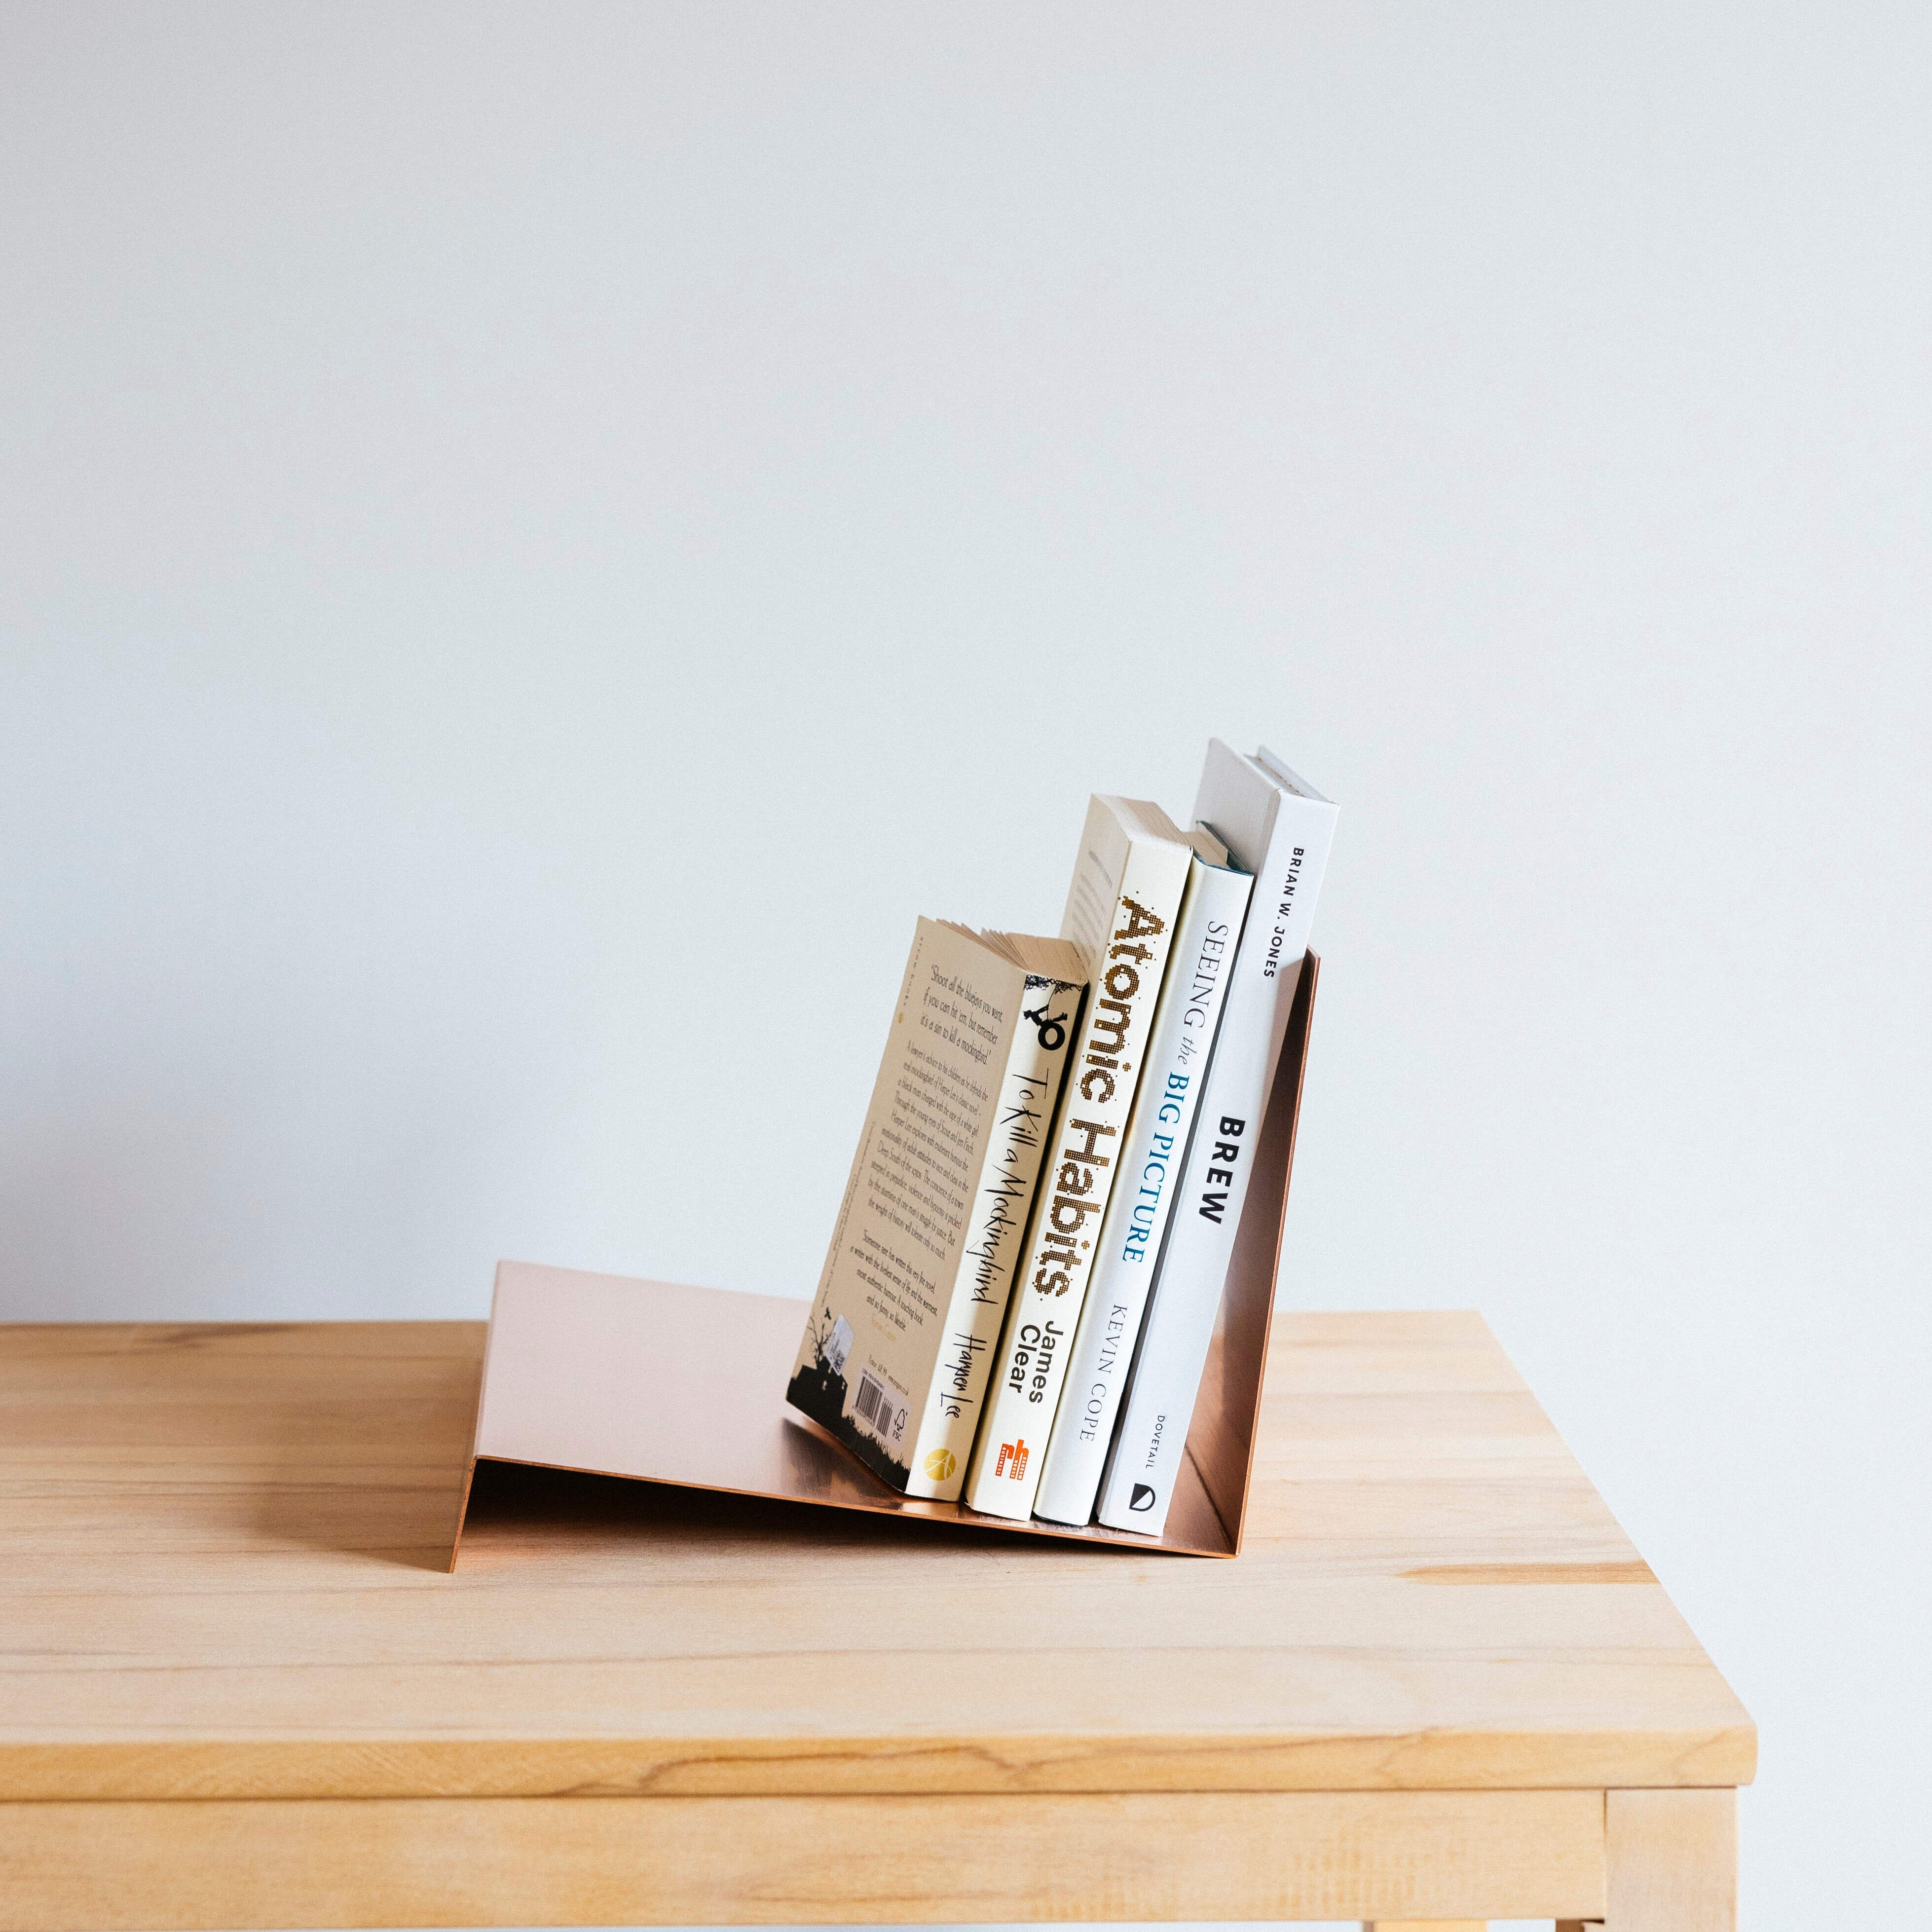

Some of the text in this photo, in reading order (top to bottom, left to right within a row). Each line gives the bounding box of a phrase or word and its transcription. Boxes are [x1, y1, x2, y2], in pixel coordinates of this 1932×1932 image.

[1264, 847, 1304, 978] BRIAN W. JONES
[924, 987, 930, 1005] if
[928, 996, 939, 1008] you
[940, 1002, 950, 1014] can
[976, 1024, 998, 1044] remember
[949, 976, 958, 991] all
[965, 984, 982, 1009] bluejays
[982, 1002, 991, 1014] you
[992, 1008, 1003, 1023] want,
[1078, 894, 1166, 1104] Atomic
[942, 1028, 948, 1039] to
[949, 1026, 958, 1043] kill
[957, 1038, 961, 1046] a
[933, 1076, 939, 1090] of
[938, 1078, 950, 1096] Harper
[968, 1104, 979, 1116] novel
[948, 1066, 961, 1083] children
[965, 1076, 970, 1089] he
[969, 1078, 982, 1098] defends
[1122, 921, 1228, 1263] SEEING the BIG PICTURE
[921, 1089, 937, 1107] charged
[957, 1113, 963, 1125] of
[916, 1110, 929, 1125] young
[936, 1119, 942, 1133] of
[940, 1120, 951, 1138] Scout
[950, 1131, 959, 1143] and
[901, 1157, 908, 1171] of
[947, 1189, 953, 1204] of
[955, 1198, 963, 1210] town
[950, 1170, 958, 1186] class
[958, 1178, 962, 1189] in
[966, 1068, 1049, 1305] To Kill a Mockingbird
[1199, 1116, 1246, 1225] BREW
[888, 1208, 894, 1223] of
[896, 1194, 902, 1208] of
[923, 1194, 931, 1206] and
[945, 1210, 948, 1220] is
[947, 1214, 962, 1229] pricked
[1032, 1118, 1119, 1299] Habits
[867, 1295, 875, 1305] and
[901, 1279, 907, 1292] of
[897, 1295, 901, 1306] A
[901, 1301, 914, 1320] touching
[940, 1333, 987, 1419] Harper Lee
[1009, 1324, 1041, 1394] Clear
[1029, 1321, 1064, 1404] James
[1079, 1304, 1127, 1442] KEVIN COPE
[892, 1430, 901, 1441] FSC
[1146, 1414, 1165, 1469] DOVETAIL
[997, 1447, 1007, 1476] BUSINESS
[1010, 1459, 1019, 1479] HOUSE
[1017, 1456, 1027, 1480] RANDOM
